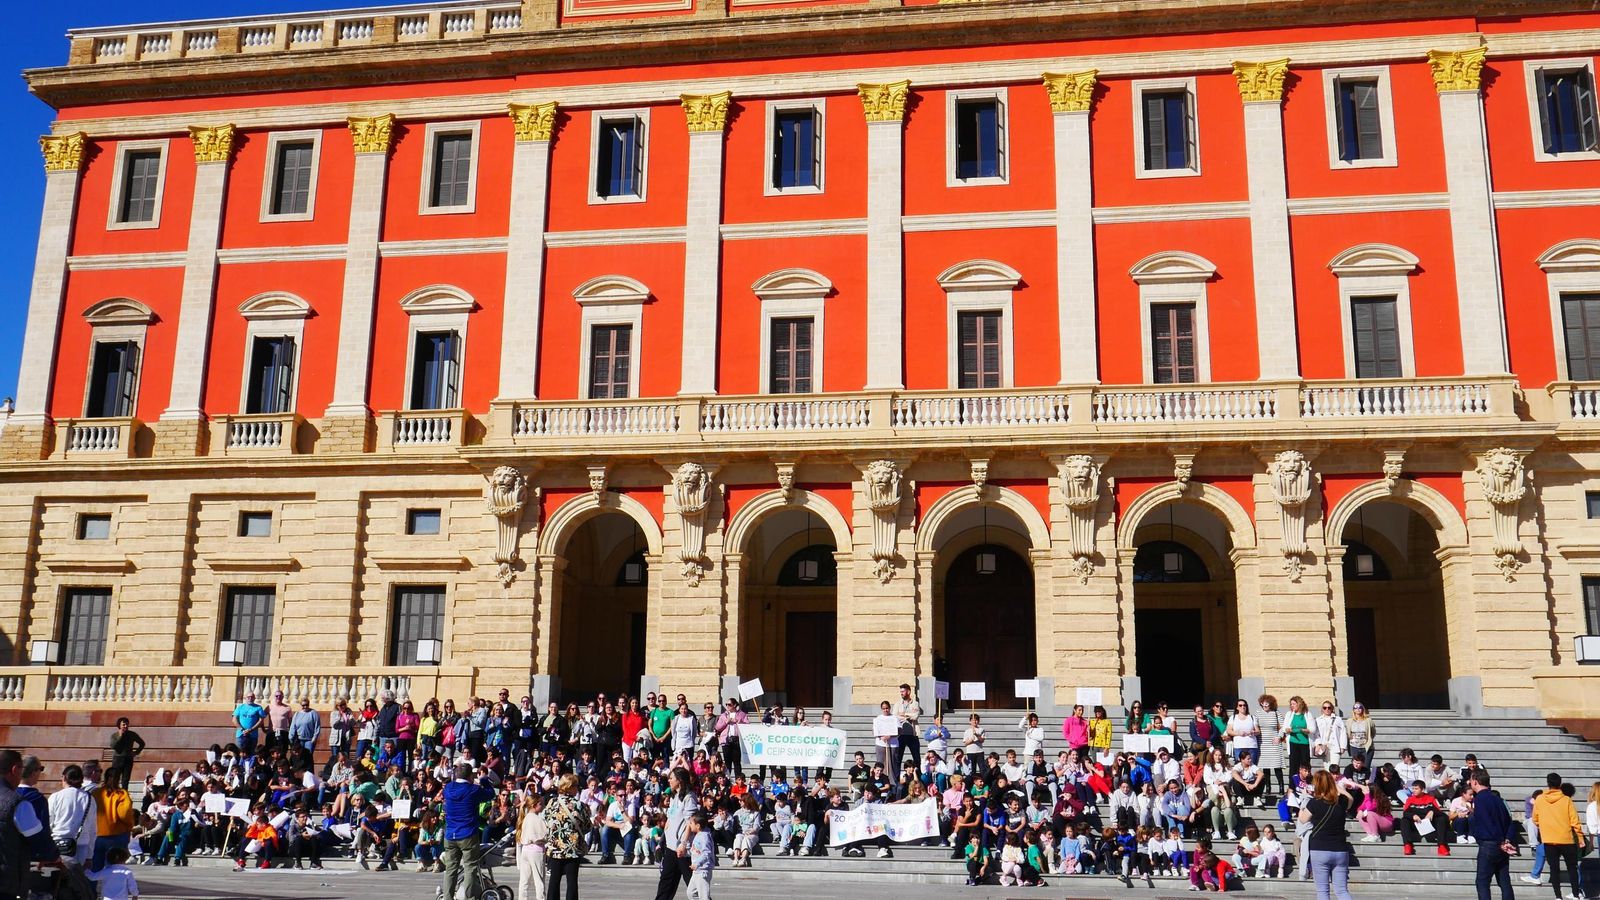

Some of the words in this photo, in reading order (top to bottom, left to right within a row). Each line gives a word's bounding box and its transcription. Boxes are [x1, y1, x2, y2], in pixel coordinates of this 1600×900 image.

[767, 734, 840, 747] ECOESCUELA
[766, 746, 786, 756] CEIP
[787, 747, 803, 757] SAN
